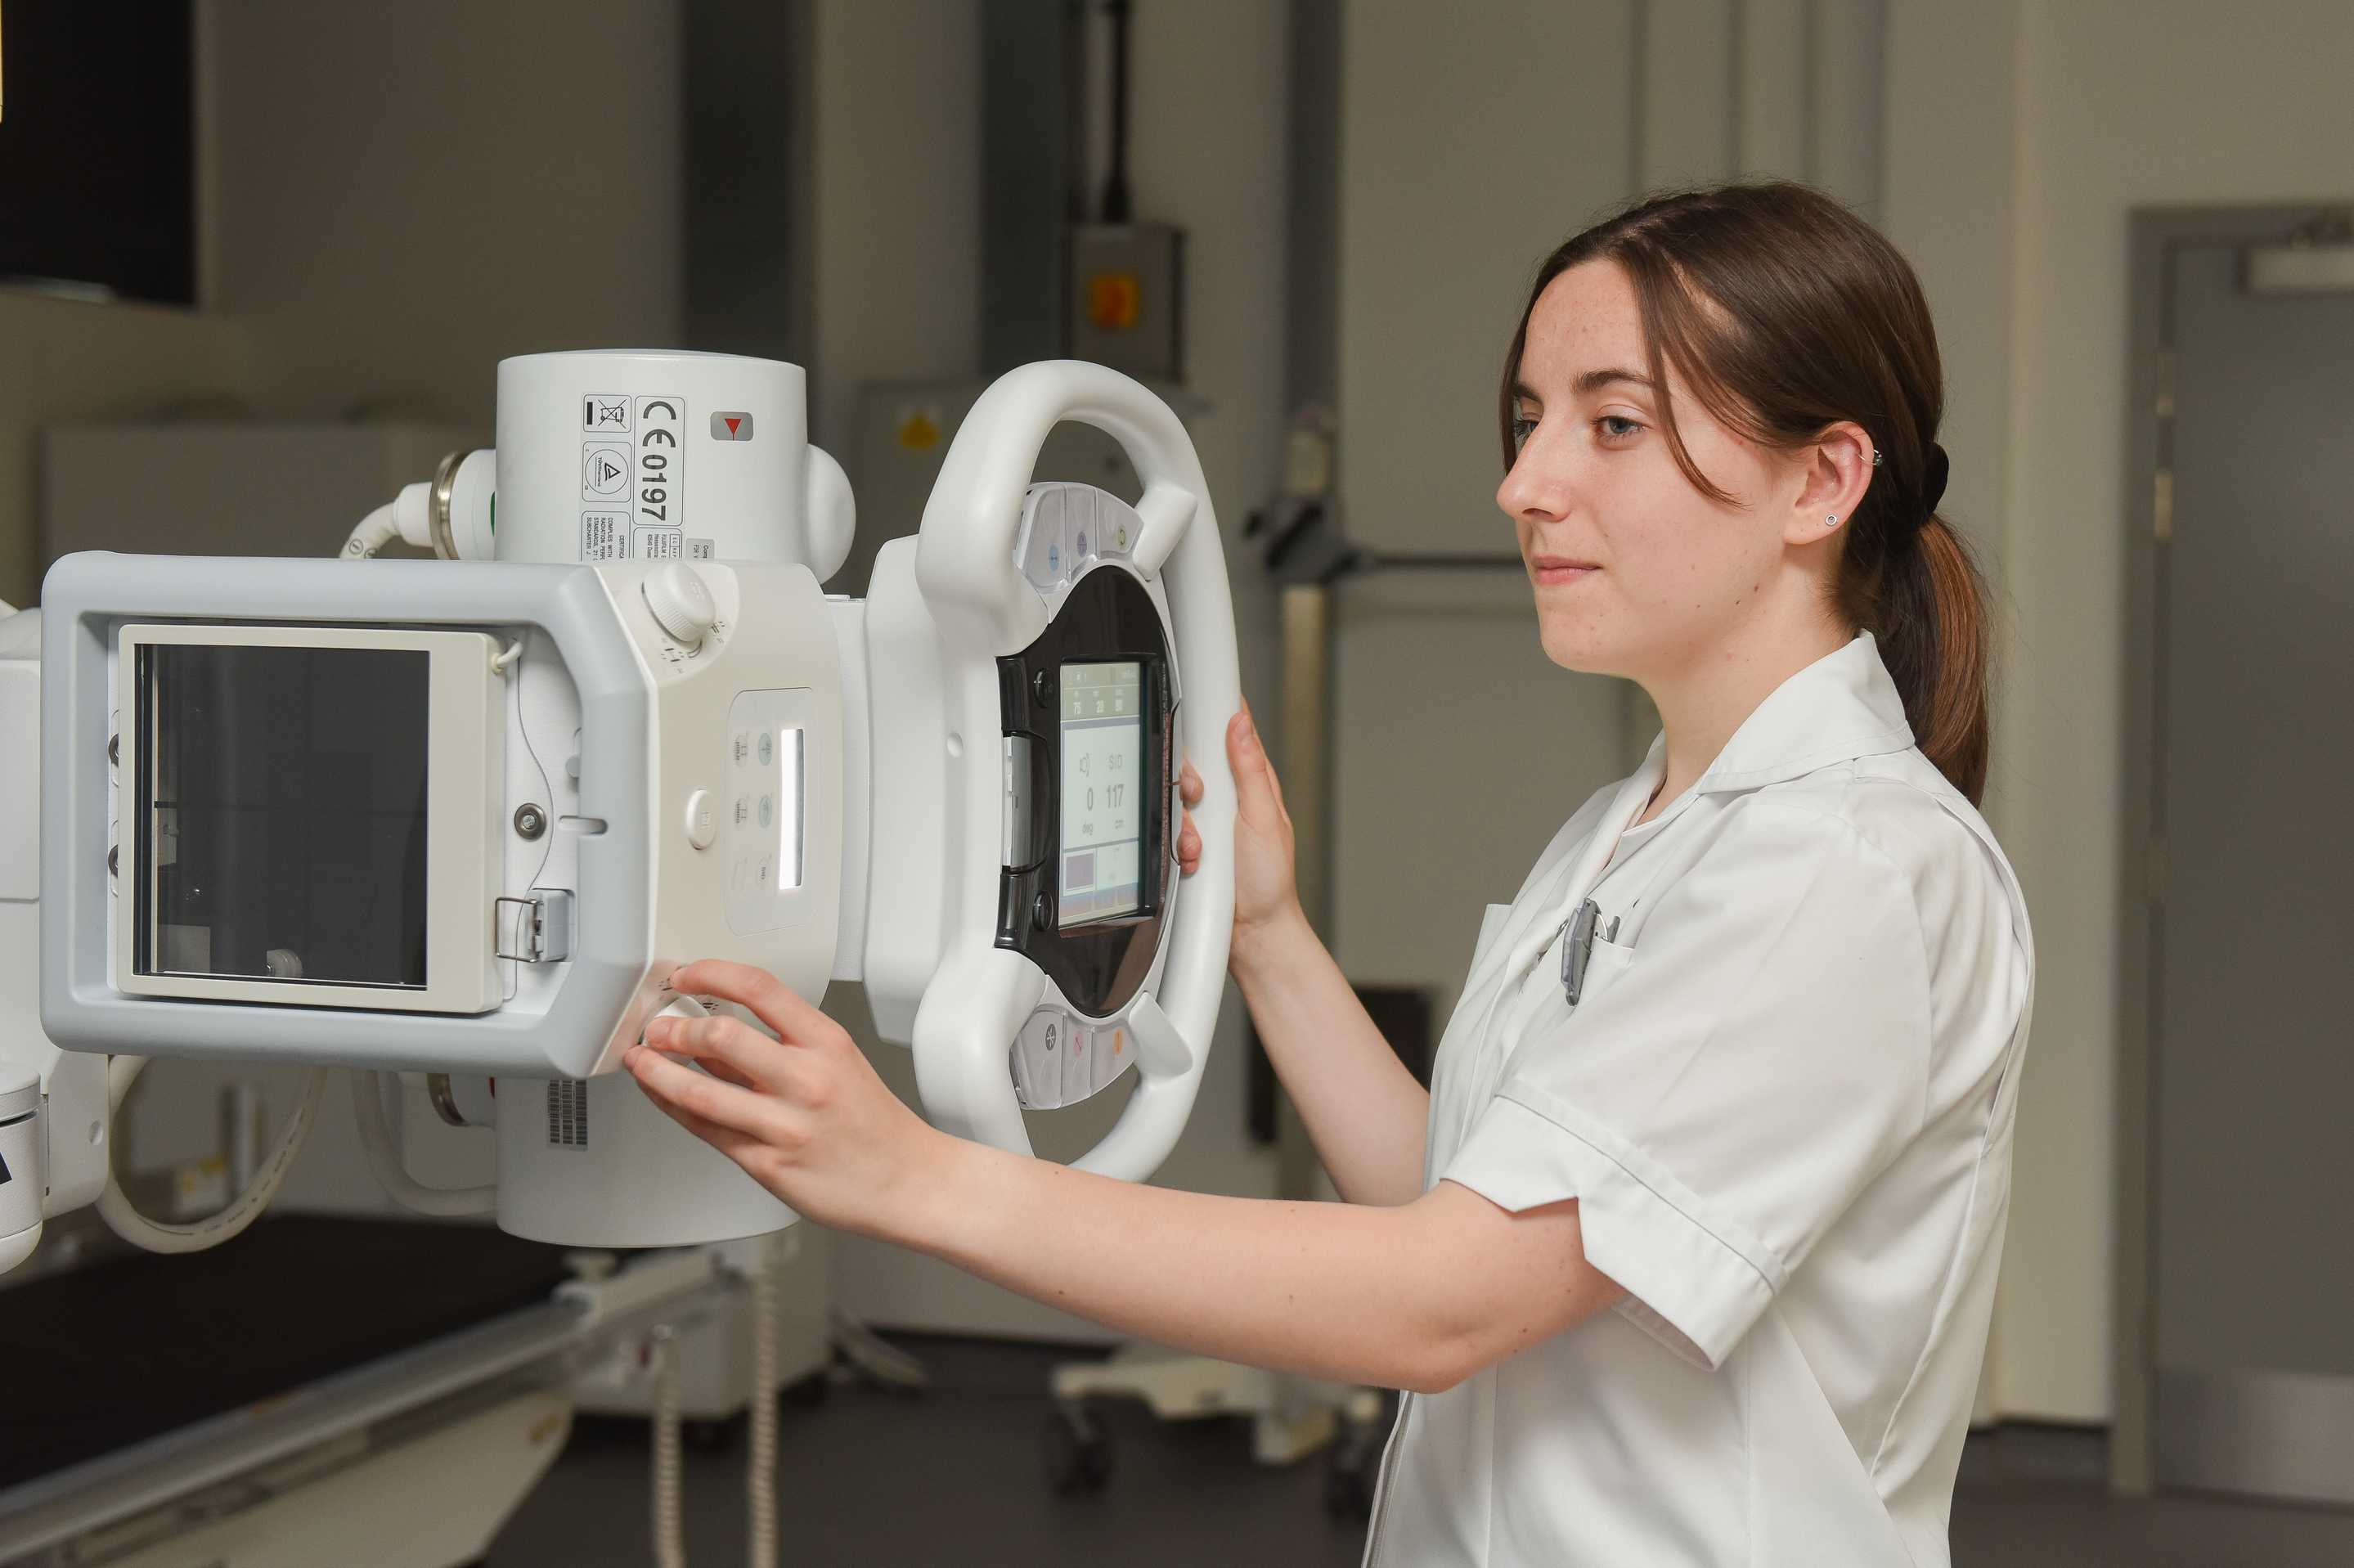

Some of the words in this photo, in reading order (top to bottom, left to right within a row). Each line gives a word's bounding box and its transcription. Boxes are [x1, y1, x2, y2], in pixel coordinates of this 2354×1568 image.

[641, 454, 667, 521] 0197
[1087, 786, 1094, 811] 0
[1107, 783, 1125, 809] 117
